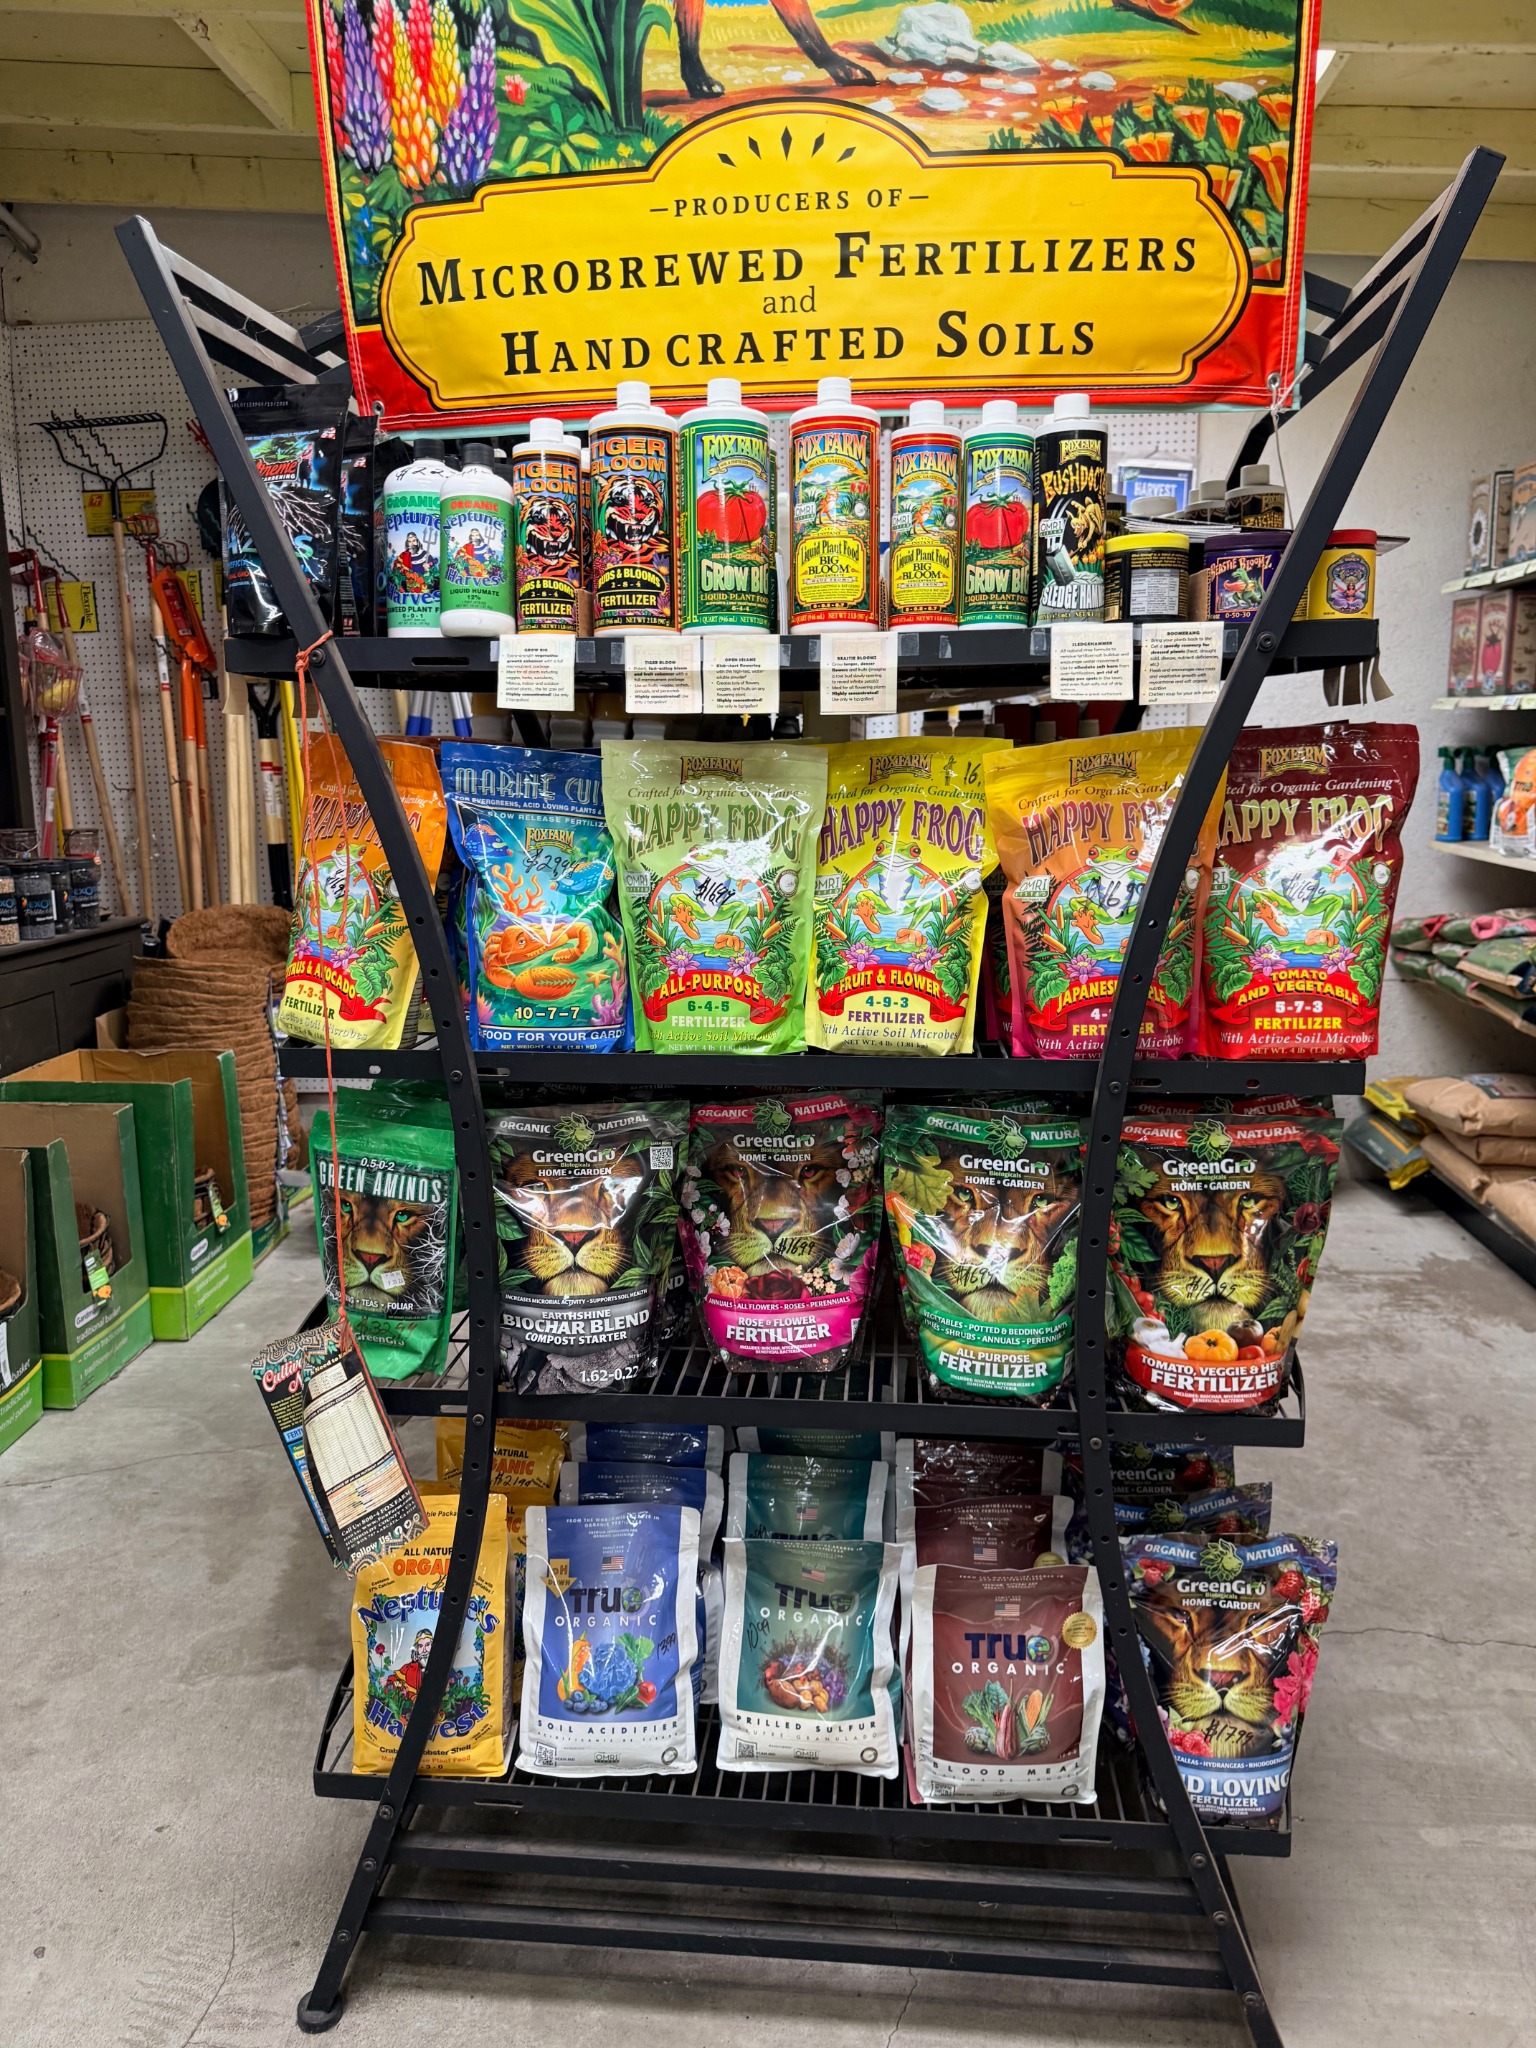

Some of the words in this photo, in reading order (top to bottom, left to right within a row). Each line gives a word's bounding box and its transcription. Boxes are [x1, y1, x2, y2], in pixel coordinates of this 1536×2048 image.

[419, 244, 802, 306] MICROBREWED
[832, 230, 1197, 280] FERTILIZERS
[763, 285, 818, 315] and
[936, 309, 1095, 359] SOILS
[591, 438, 665, 456] TIGER
[513, 463, 577, 480] TIGER
[591, 456, 666, 473] BLOOM
[514, 479, 577, 495] BLOOM
[450, 499, 498, 512] ORGANIC
[801, 545, 820, 565] Liquid
[822, 541, 840, 556] Plant
[843, 543, 859, 561] Food
[819, 555, 839, 564] BIG
[916, 550, 933, 563] Plant
[935, 551, 950, 568] Food
[913, 562, 931, 571] BIG
[447, 566, 507, 588] Harvest
[624, 568, 660, 587] BLOOMS
[701, 560, 749, 592] GROW
[966, 567, 1009, 594] GROW
[83, 586, 92, 624] Flexrake
[600, 593, 657, 608] FERTILIZER
[521, 603, 572, 616] FERTILIZER
[1225, 611, 1251, 619] 0-50-30
[455, 767, 556, 797] MARINE
[1271, 780, 1322, 796] Organic
[881, 784, 924, 796] Organic
[927, 785, 985, 803] Gardening
[1018, 790, 1060, 811] Crafted
[1085, 785, 1131, 800] Organic
[543, 803, 567, 812] LOVING
[568, 805, 593, 814] PLANTS
[819, 798, 906, 866] HAPPY
[911, 799, 986, 862] FROG
[1022, 801, 1115, 867] HAPPY
[1019, 878, 1048, 892] OMRI
[840, 968, 875, 995] FRUIT
[890, 969, 941, 998] FLOWER
[1270, 969, 1328, 982] TOMATO
[659, 973, 760, 1002] ALL-PURPOSE
[1237, 984, 1270, 1005] AND
[1274, 980, 1359, 1006] VEGETABLE
[687, 1000, 729, 1012] 6-4-5
[866, 996, 910, 1008] 4-9-3
[1275, 1001, 1323, 1013] 5-7-3
[671, 1014, 746, 1028] FERTILIZER
[848, 1009, 925, 1025] FERTILIZER
[1254, 1017, 1343, 1030] FERTILIZER
[517, 1032, 544, 1041] FOR
[549, 1032, 586, 1041] YOUR
[842, 1026, 879, 1037] Active
[883, 1027, 907, 1038] Soil
[910, 1025, 958, 1040] Microbes
[1247, 1032, 1290, 1045] Active
[1295, 1031, 1322, 1044] Soil
[697, 1109, 749, 1119] ORGANIC
[794, 1099, 847, 1117] NATURAL
[500, 1120, 551, 1134] ORGANIC
[597, 1114, 649, 1132] NATURAL
[926, 1116, 981, 1137] ORGANIC
[733, 1134, 816, 1147] GreenGro
[1124, 1125, 1182, 1139] ORGANIC
[1236, 1125, 1300, 1140] NATURAL
[532, 1149, 616, 1163] GreenGro
[738, 1153, 767, 1162] HOME
[774, 1153, 811, 1162] GARDEN
[573, 1167, 612, 1176] GARDEN
[959, 1153, 1050, 1176] GreenGro
[1163, 1157, 1255, 1175] GreenGro
[319, 1160, 365, 1194] GREEN
[373, 1168, 443, 1203] AMINOS
[965, 1175, 994, 1186] HOME
[1002, 1179, 1045, 1190] GARDEN
[1171, 1181, 1203, 1192] HOME
[1208, 1181, 1250, 1191] GARDEN
[362, 1299, 379, 1308] TEAS
[387, 1301, 414, 1311] FOLIAR
[750, 1303, 780, 1311] FLOWERS
[810, 1296, 851, 1308] PERENNIALS
[502, 1312, 585, 1335] BIOCHAR
[590, 1309, 650, 1333] BLEND
[541, 1309, 611, 1321] EARTHSHINE
[738, 1316, 763, 1327] ROSE
[773, 1315, 816, 1327] FLOWER
[726, 1323, 832, 1343] FERTILIZER
[969, 1323, 1000, 1335] POTTED
[1008, 1325, 1044, 1336] BEDDING
[1045, 1320, 1068, 1334] PLANTS
[525, 1332, 576, 1346] COMPOST
[578, 1330, 627, 1345] STARTER
[945, 1327, 976, 1341] SHRUBS
[982, 1334, 1021, 1346] ANNUALS
[957, 1347, 974, 1359] ALL
[976, 1350, 1030, 1363] PURPOSE
[939, 1350, 1048, 1378] FERTILIZER
[1141, 1354, 1197, 1376] TOMATO,
[1200, 1366, 1248, 1376] VEGGIE
[1151, 1369, 1279, 1393] FERTILIZER
[1189, 1495, 1238, 1515] NATURAL
[350, 1541, 379, 1562] Follow
[378, 1532, 393, 1546] Us!
[404, 1548, 421, 1556] ALL
[1143, 1543, 1197, 1561] ORGANIC
[1245, 1542, 1298, 1562] NATURAL
[1177, 1580, 1267, 1596] GreenGro
[1182, 1598, 1213, 1608] HOME
[1218, 1600, 1260, 1611] GARDEN
[555, 1615, 658, 1628] ORGANIC
[760, 1607, 864, 1628] ORGANIC
[951, 1662, 1065, 1675] ORGANIC
[537, 1719, 574, 1734] SOIL
[588, 1720, 679, 1735] ACIDIFIER
[736, 1715, 802, 1731] PRILLED
[815, 1721, 877, 1733] SULFUR
[932, 1762, 1006, 1777] BLOOD
[1027, 1762, 1081, 1777] MEAL
[1203, 1759, 1245, 1770] HYDRANGEAS
[1213, 1769, 1289, 1797] LOVING
[1190, 1795, 1258, 1807] FERTILIZER
